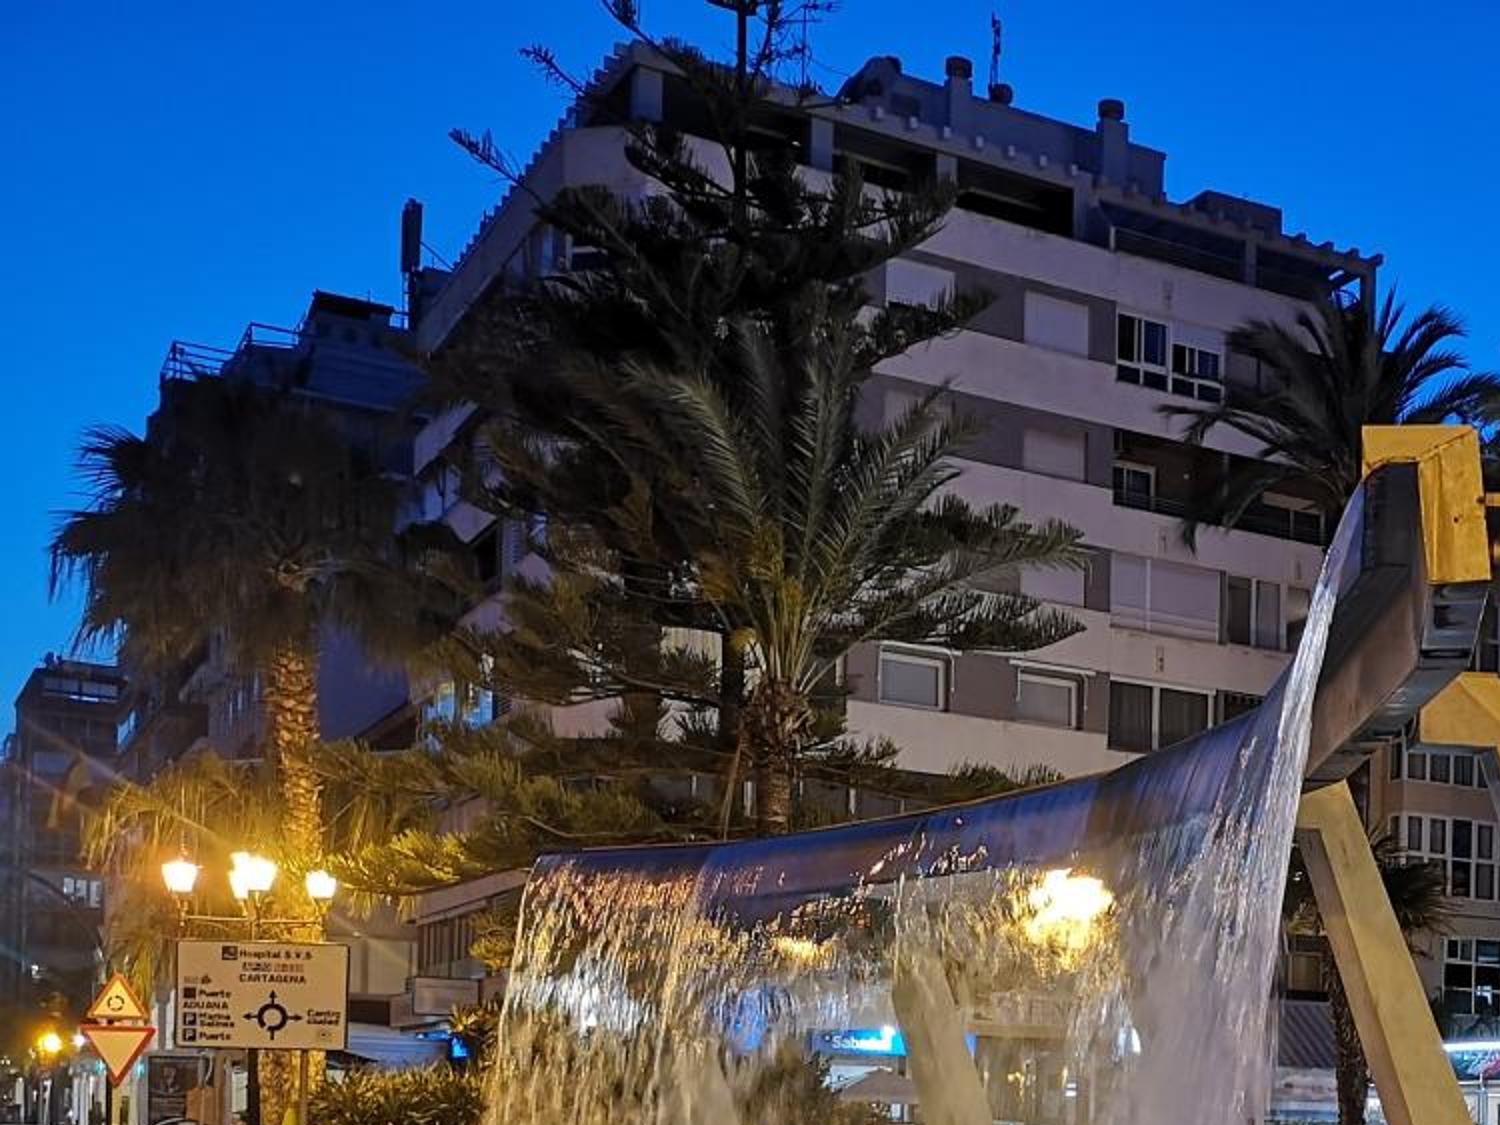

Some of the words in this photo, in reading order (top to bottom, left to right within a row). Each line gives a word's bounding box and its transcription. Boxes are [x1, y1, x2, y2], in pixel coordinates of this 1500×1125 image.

[239, 973, 306, 983] CARTAGENA
[199, 989, 231, 998] Puerto
[199, 1031, 231, 1040] Puerto
